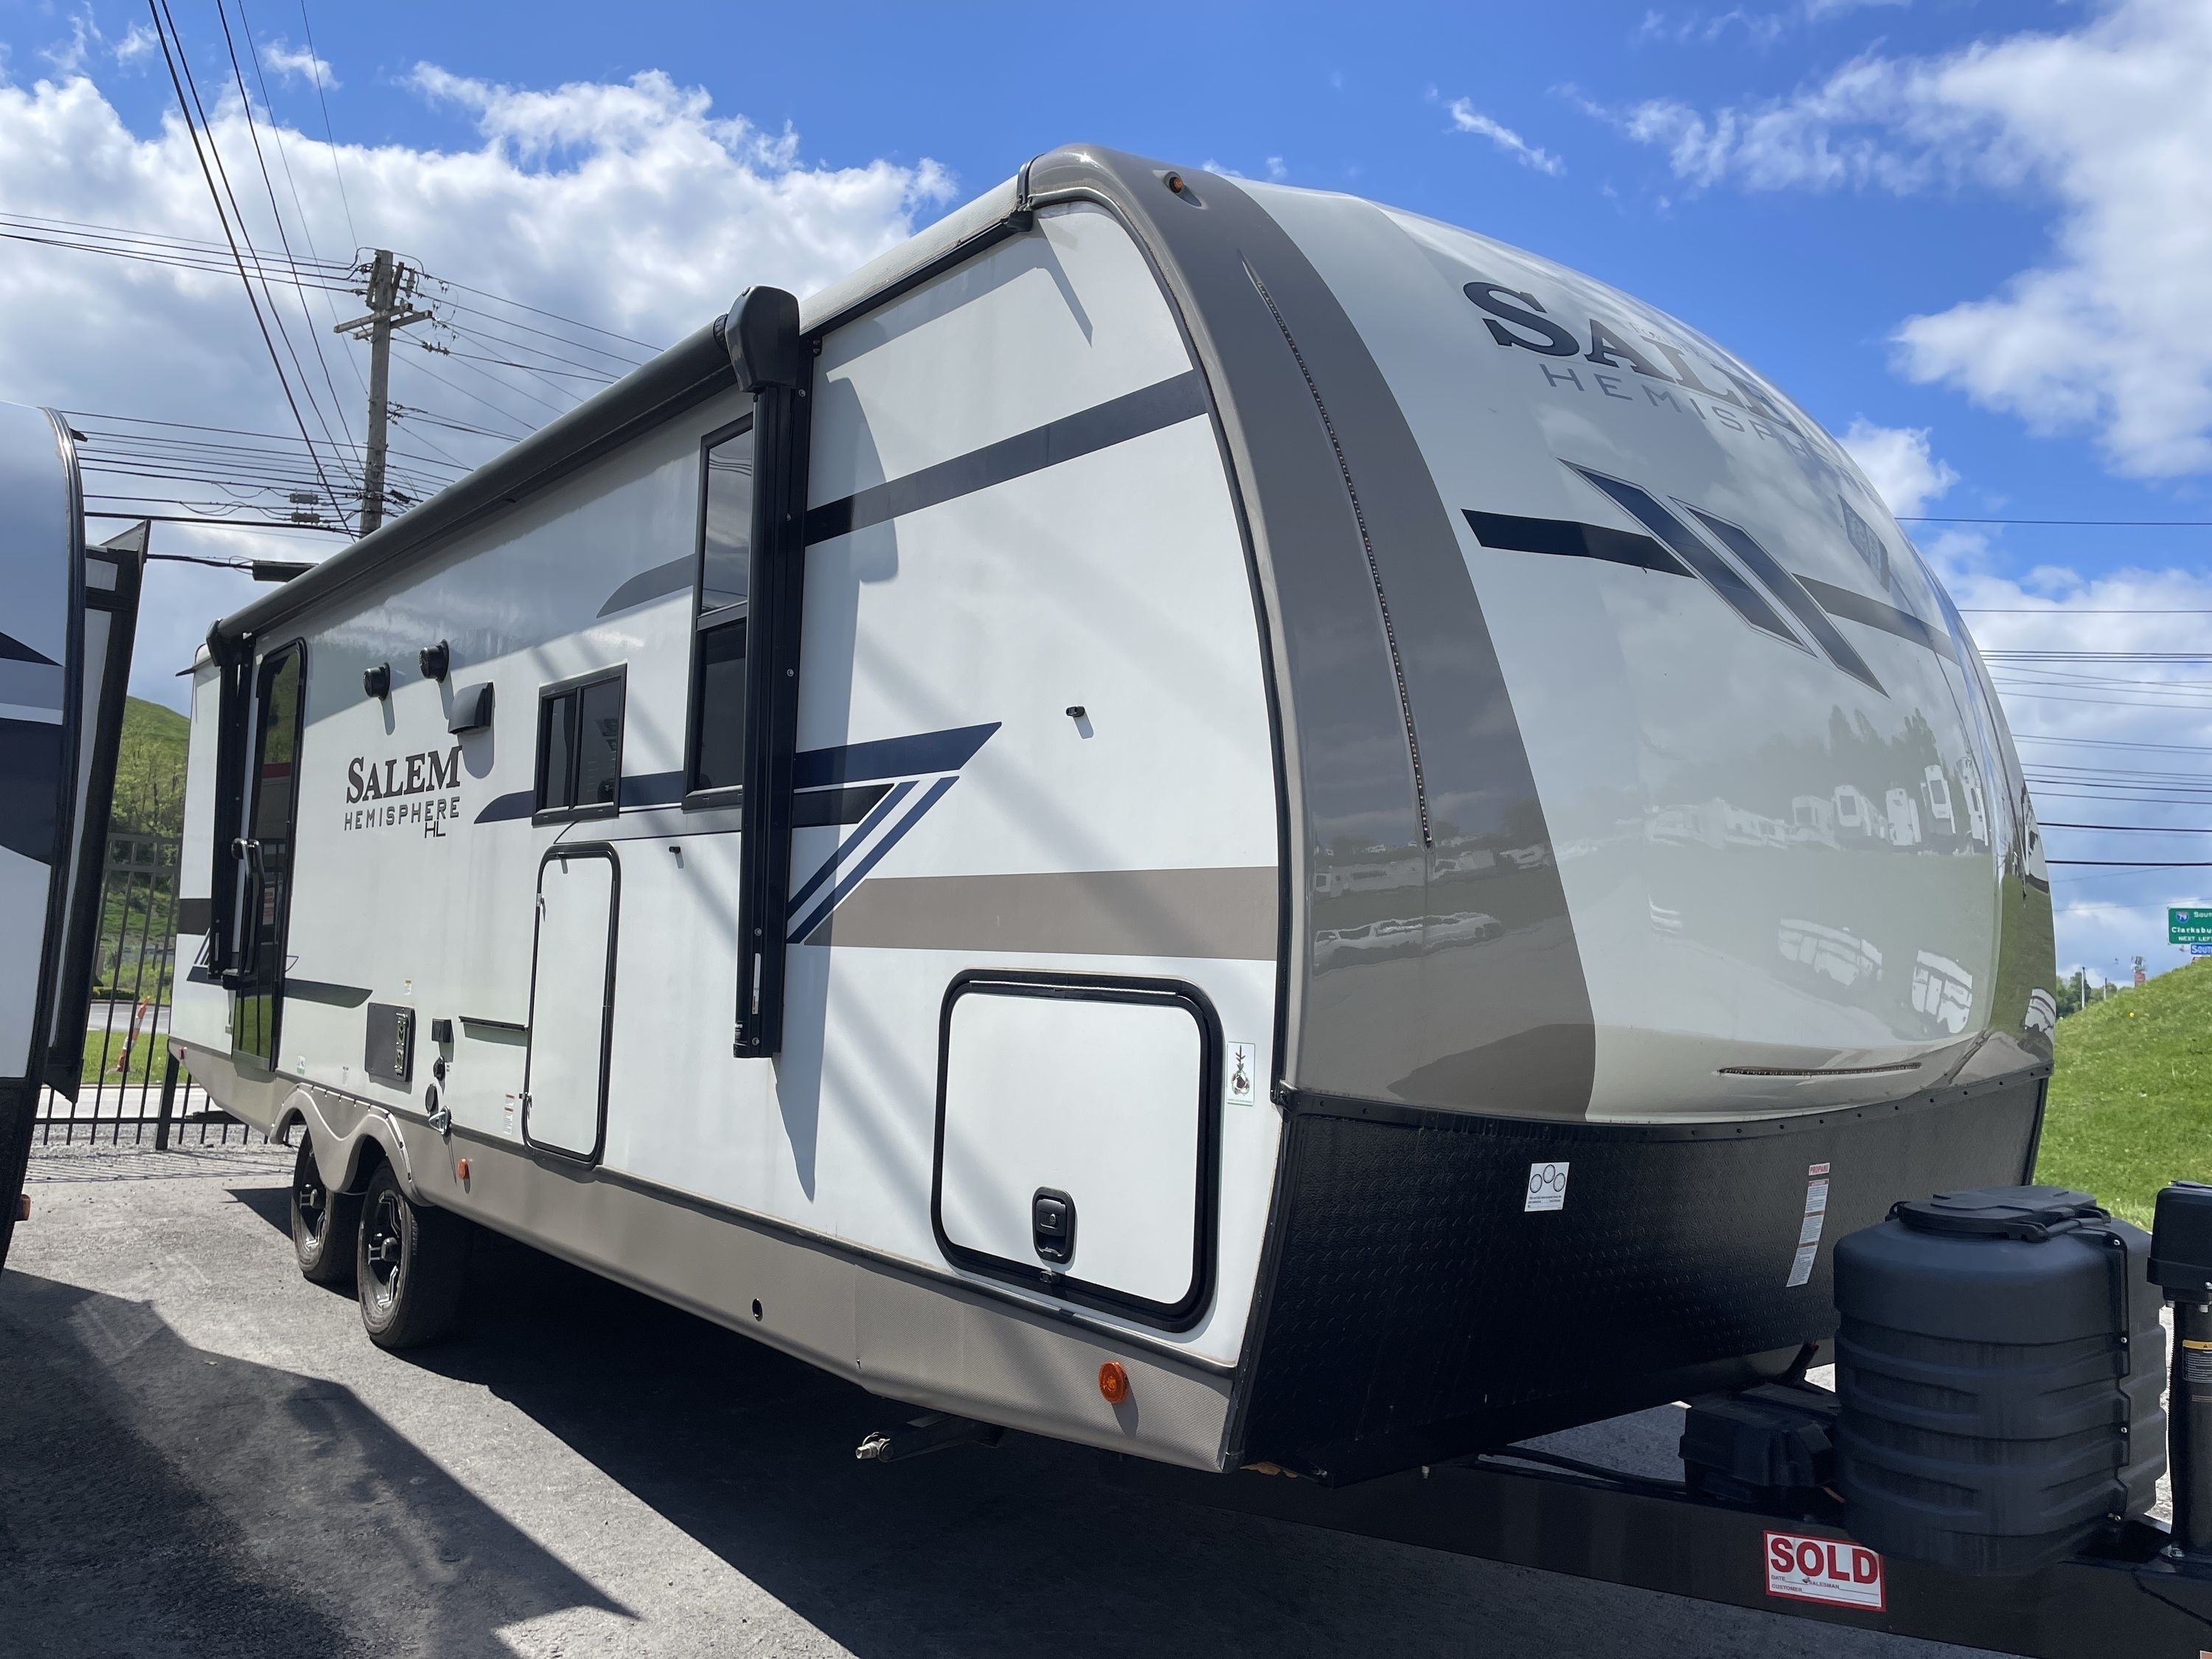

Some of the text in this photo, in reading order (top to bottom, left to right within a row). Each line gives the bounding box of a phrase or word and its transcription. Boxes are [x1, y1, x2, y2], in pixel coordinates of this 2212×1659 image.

[346, 745, 462, 804] SALEM
[344, 796, 460, 831] HEMISPHERE
[424, 821, 446, 838] HL
[1809, 1164, 1829, 1175] PROPANE
[1770, 1537, 1879, 1585] SOLD
[1771, 1583, 1803, 1593] CUSTOMER
